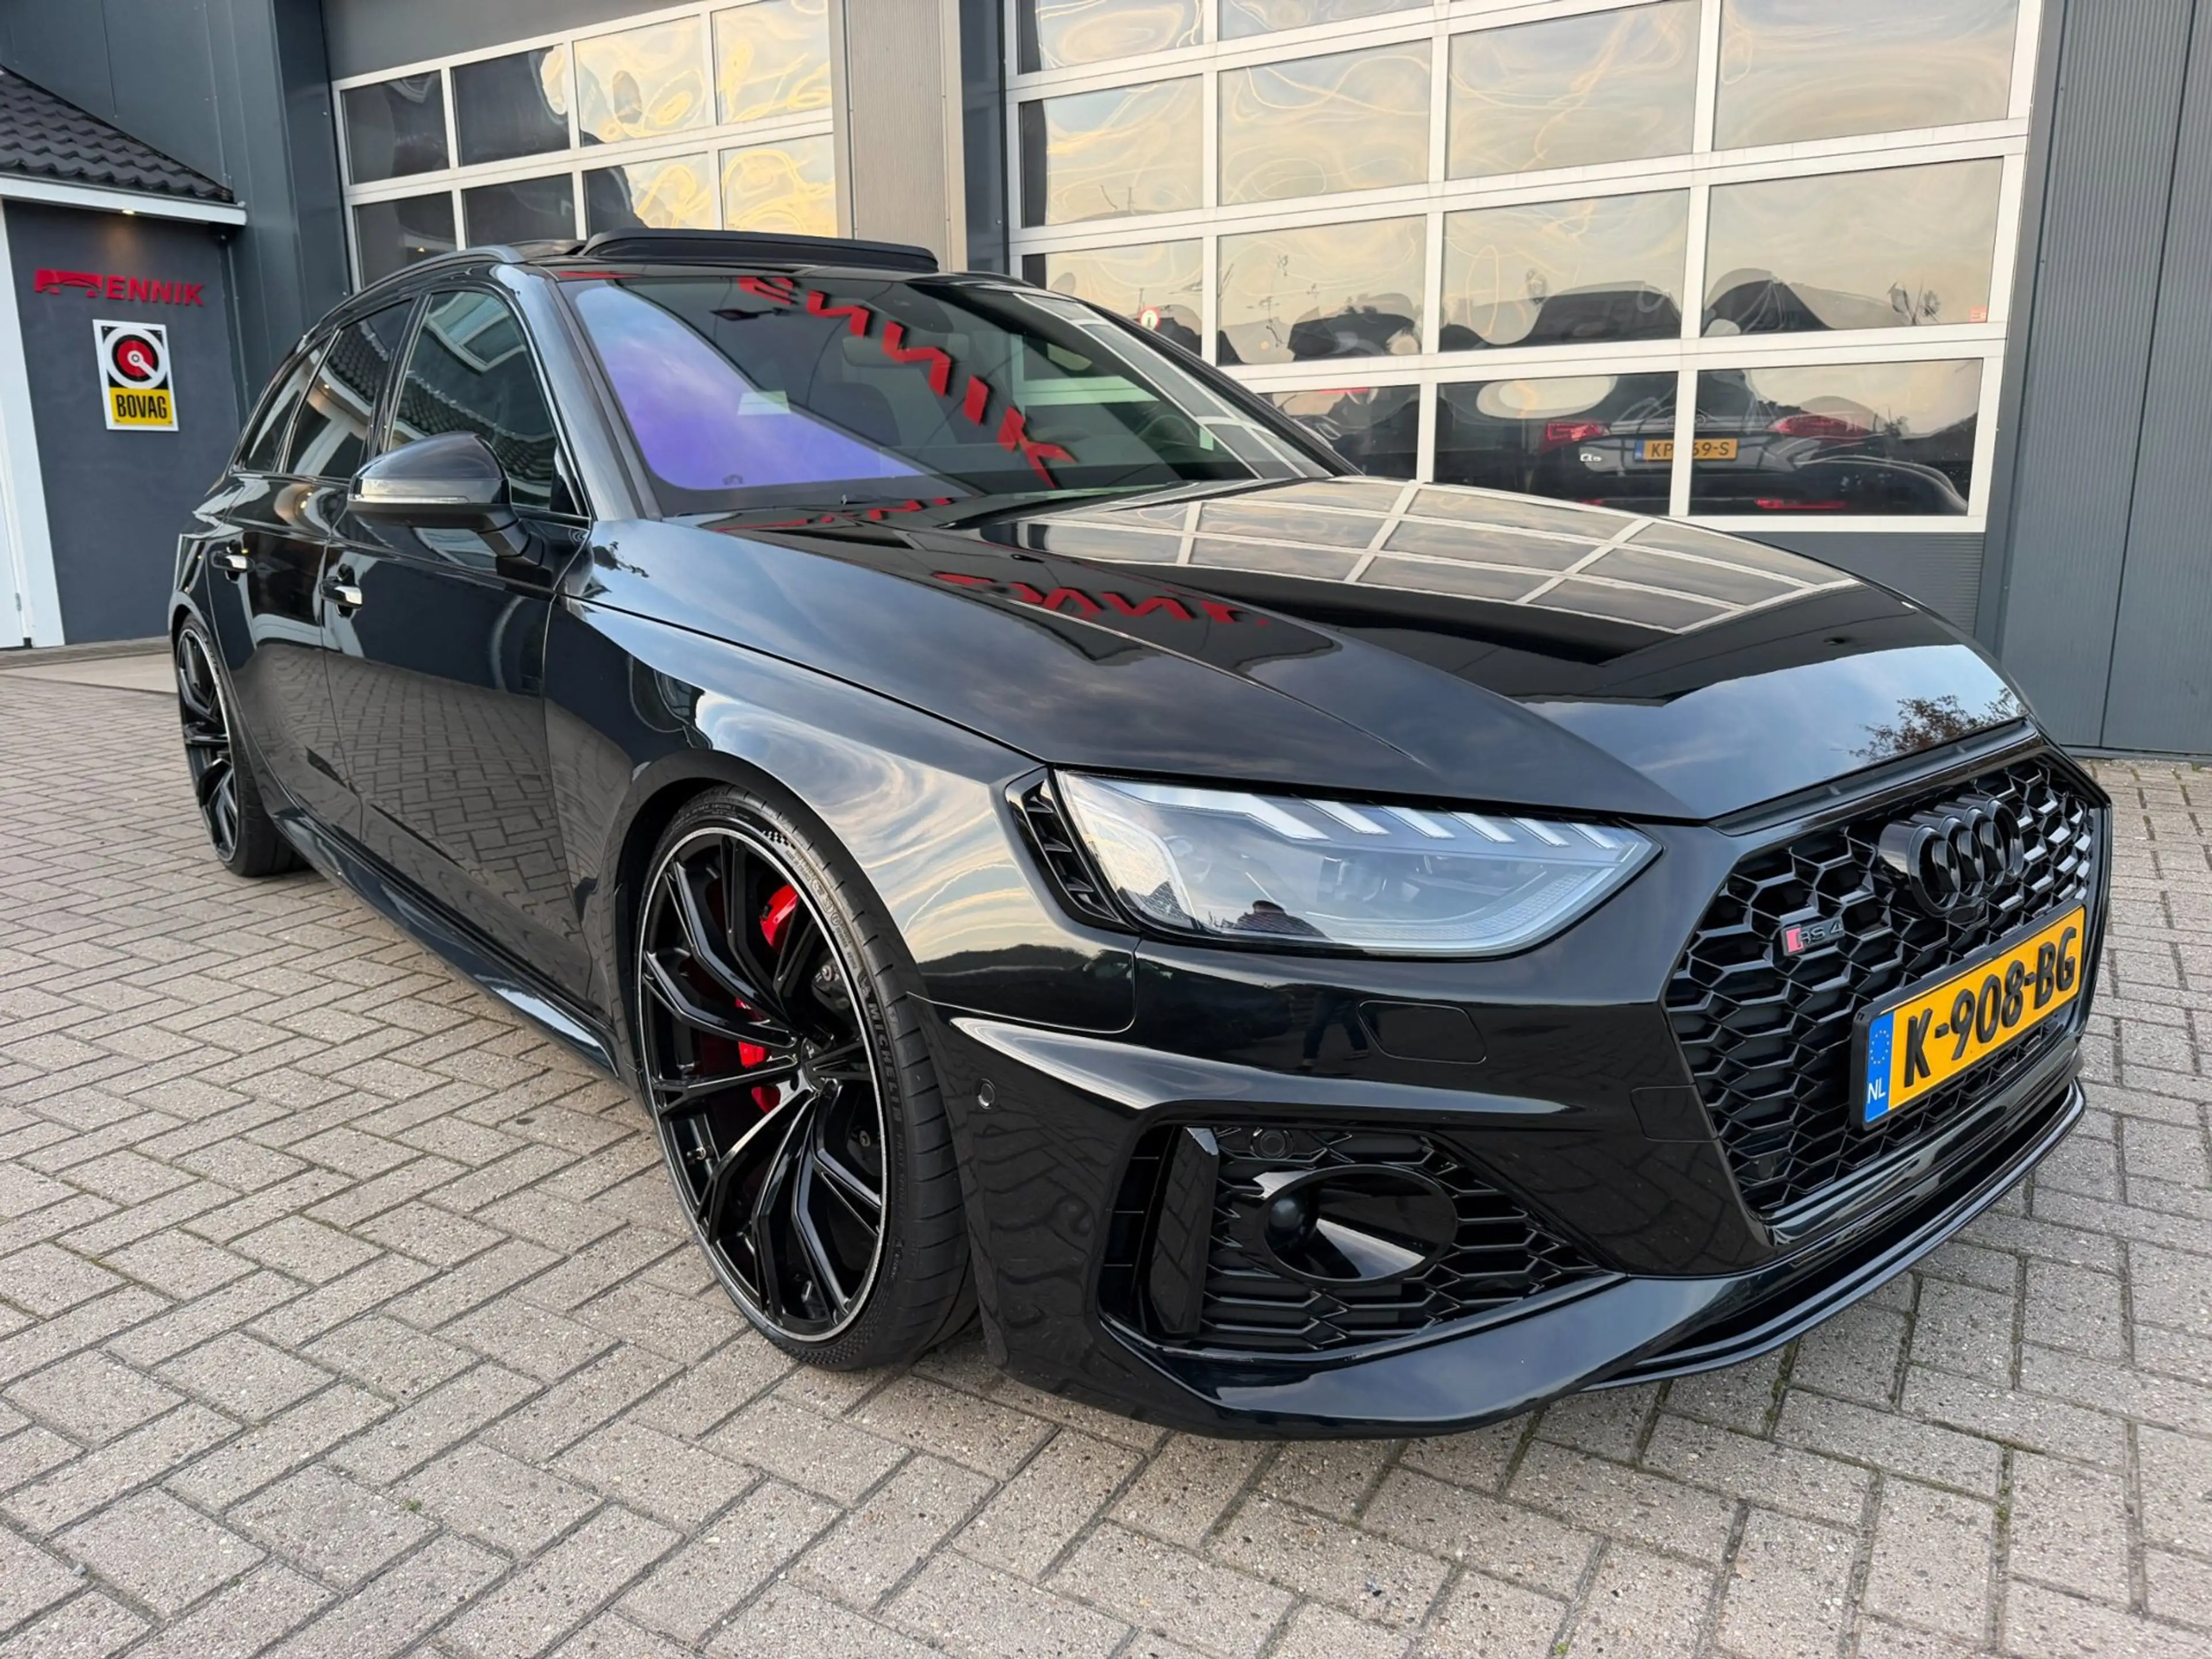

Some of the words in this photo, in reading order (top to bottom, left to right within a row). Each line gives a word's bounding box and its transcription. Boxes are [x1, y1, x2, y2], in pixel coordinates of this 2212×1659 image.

[116, 394, 167, 419] BOVAG
[1903, 926, 2077, 1088] K-908-BG
[869, 1002, 903, 1122] MICHELIN
[1867, 1078, 1887, 1104] NL
